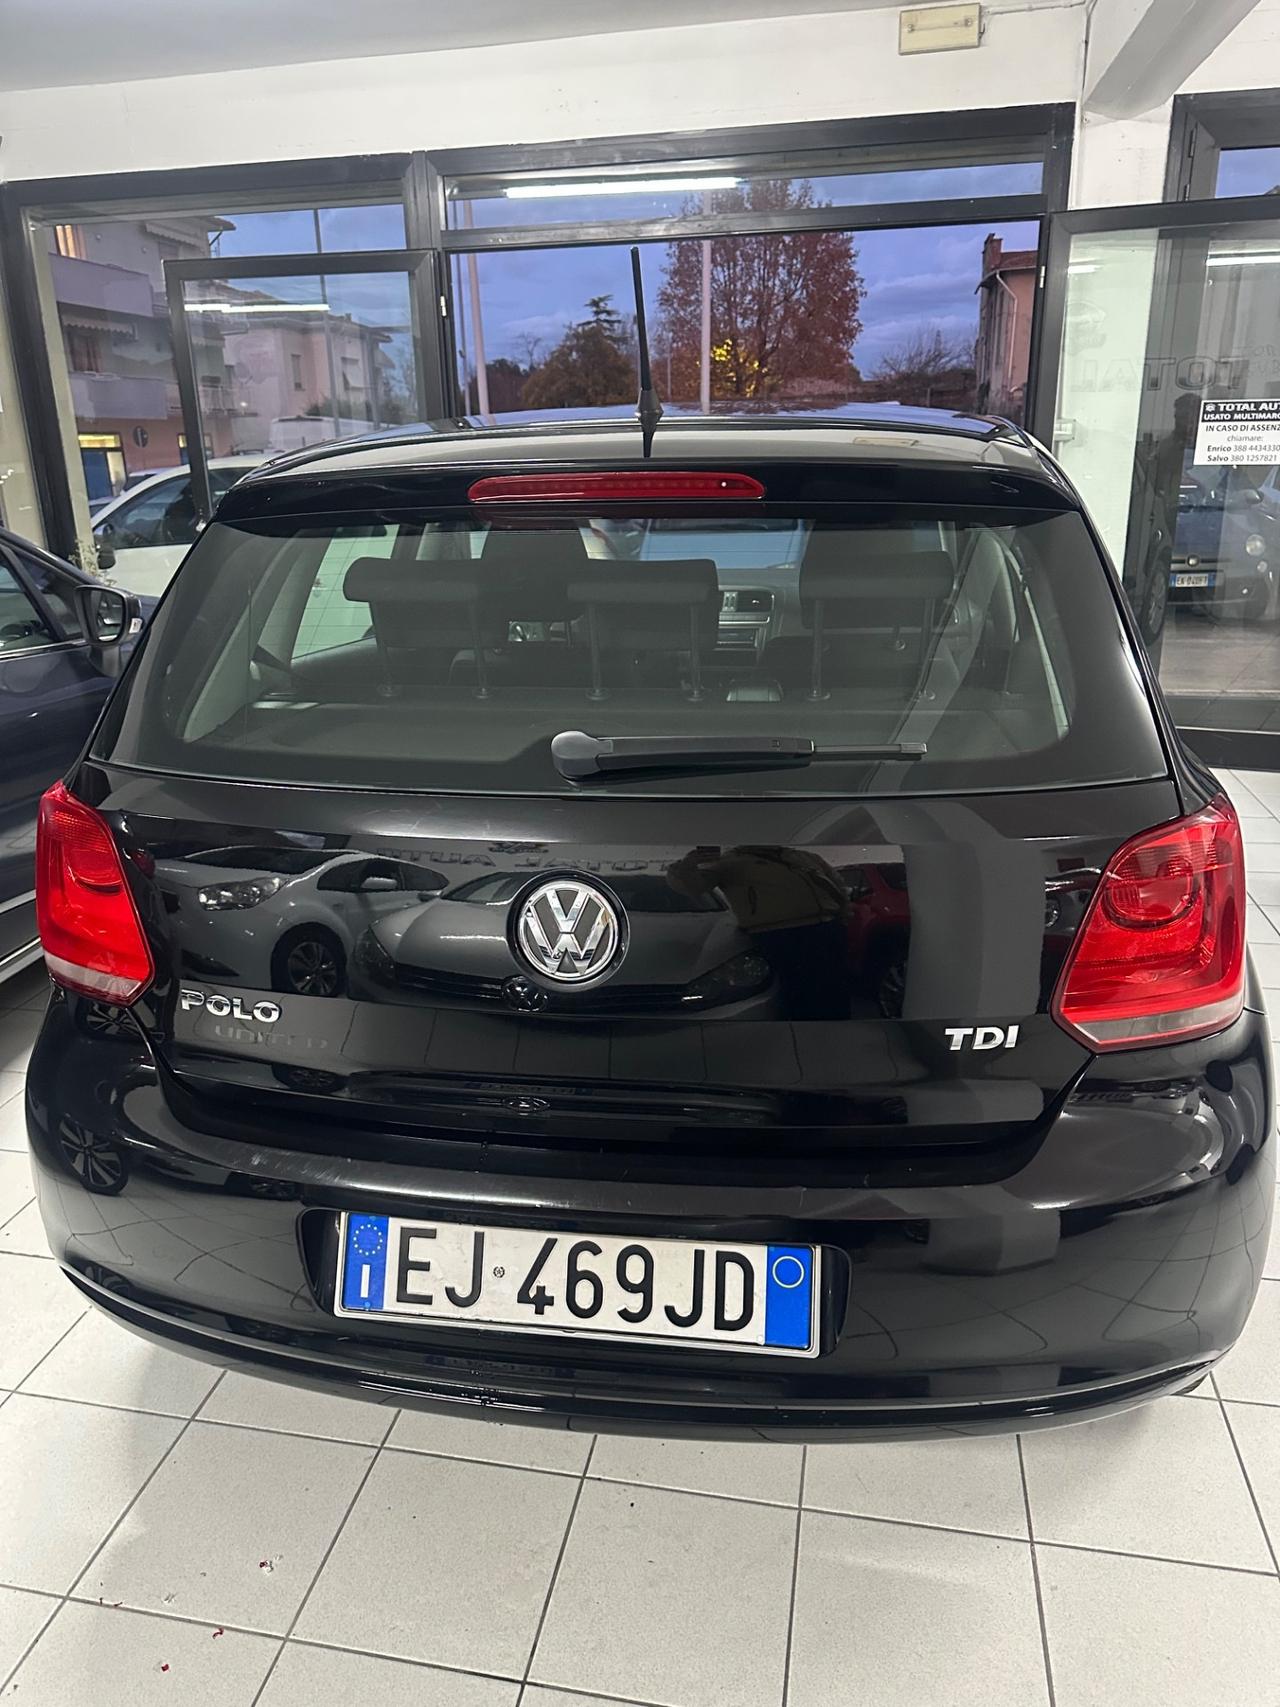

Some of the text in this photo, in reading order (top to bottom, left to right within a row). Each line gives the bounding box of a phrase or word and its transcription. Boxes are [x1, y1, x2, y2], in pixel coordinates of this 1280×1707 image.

[1217, 402, 1256, 412] TOTAL
[1216, 424, 1238, 432] CASO
[1239, 424, 1249, 432] DI
[1226, 434, 1264, 442] chiamare:
[1207, 444, 1232, 452] Enrico
[1233, 444, 1247, 452] 388
[1207, 454, 1229, 462] Salvo
[180, 989, 281, 1023] POLO
[944, 1025, 1020, 1051] TDI
[395, 1226, 485, 1308] EJ
[515, 1236, 755, 1332] 469JD
